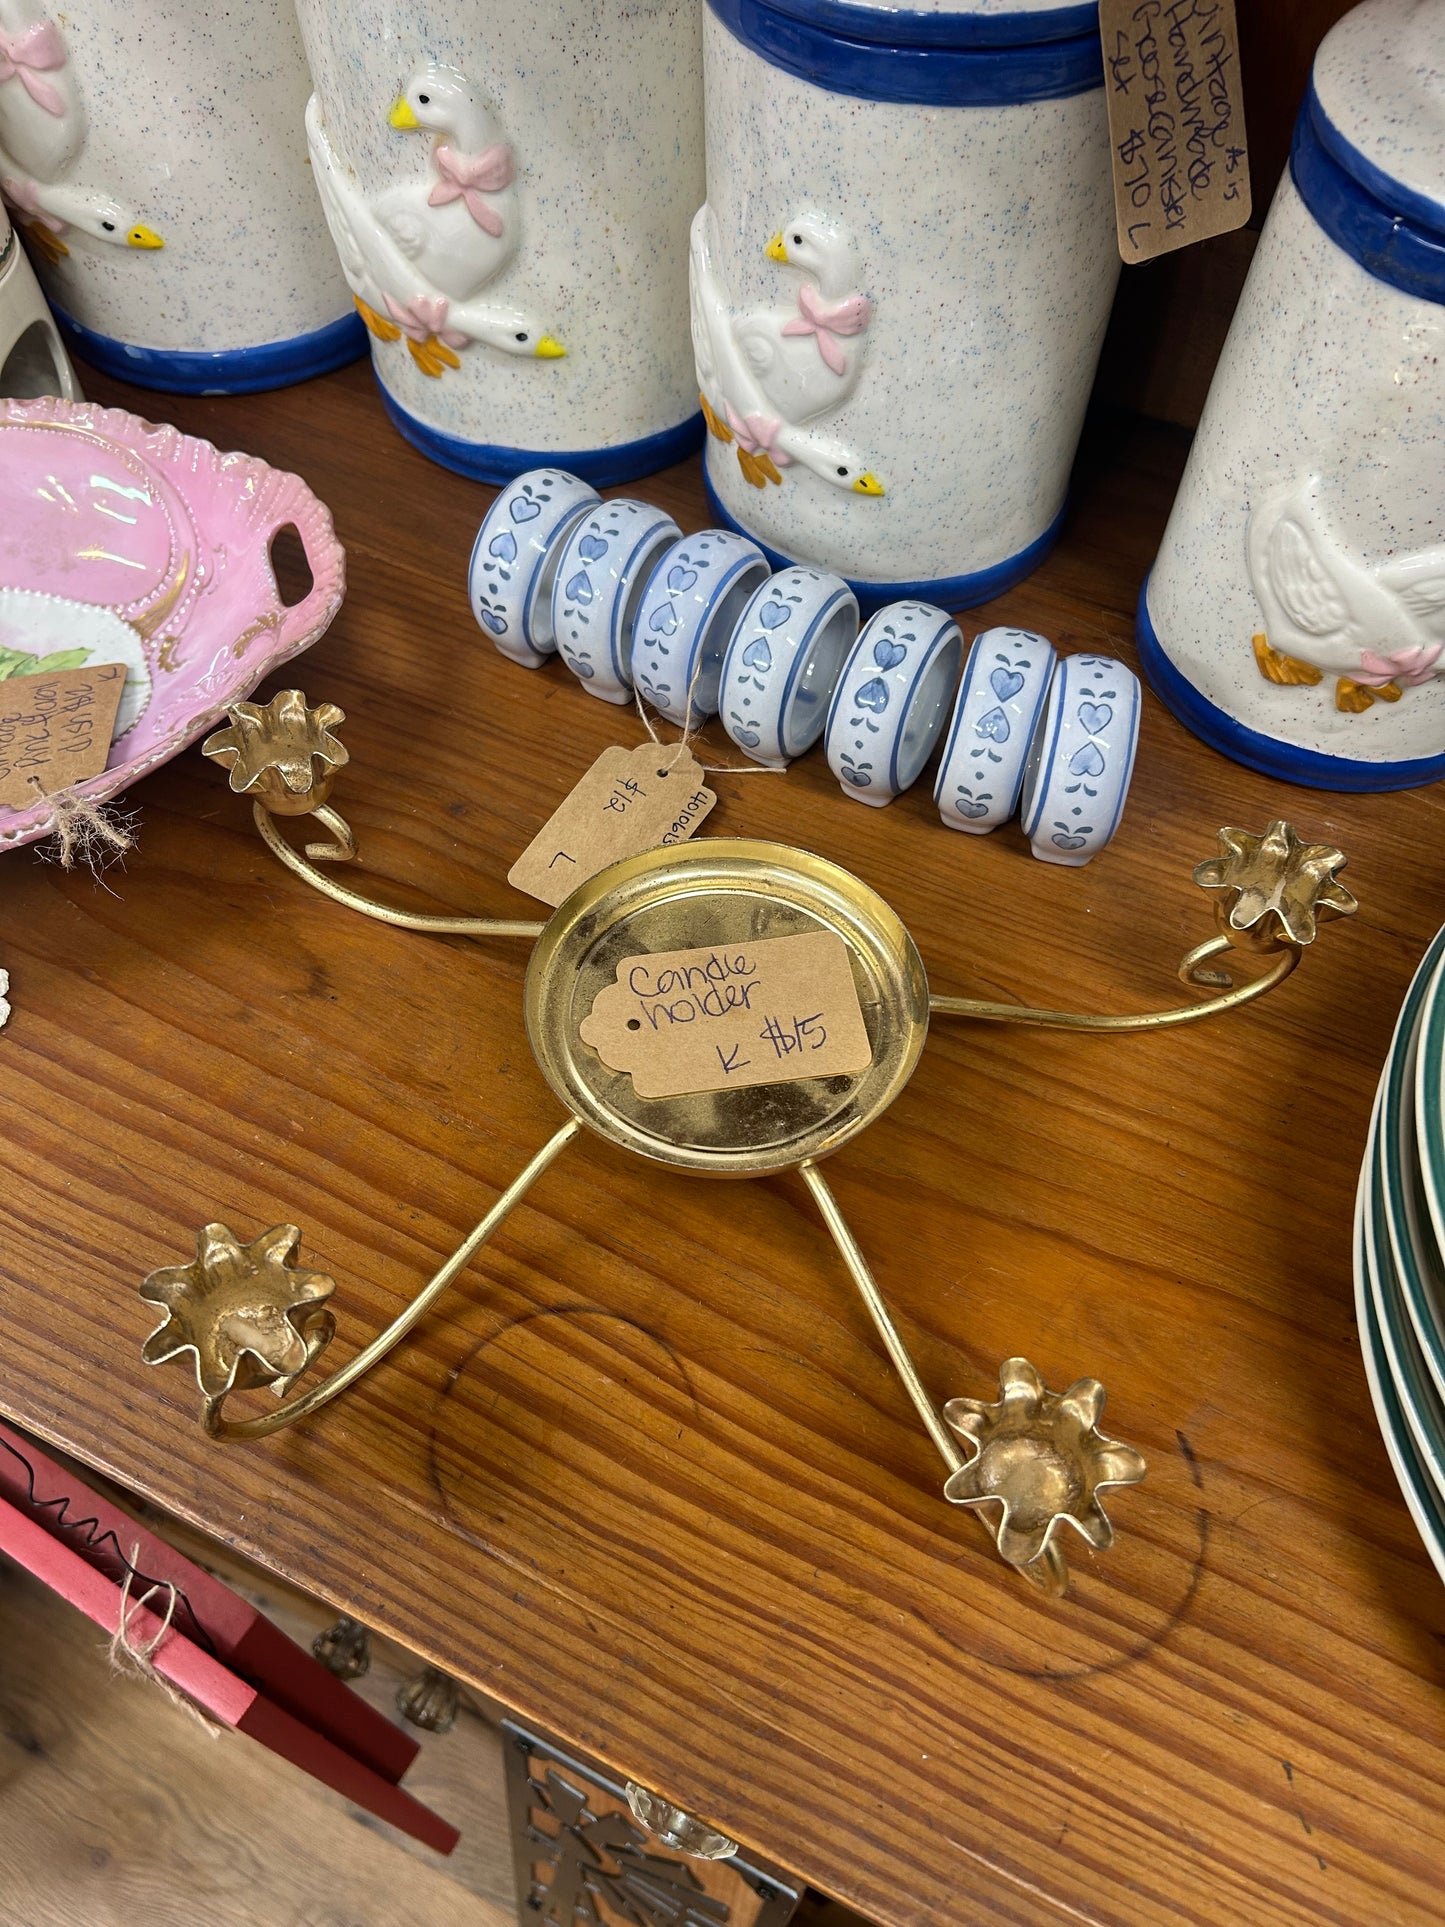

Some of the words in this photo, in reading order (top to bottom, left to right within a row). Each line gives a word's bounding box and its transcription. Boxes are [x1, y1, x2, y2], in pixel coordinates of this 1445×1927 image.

[1117, 129, 1152, 209] $70
[1127, 222, 1151, 250] L
[603, 777, 646, 813] $12
[549, 851, 577, 869] L
[629, 953, 757, 997] Candle
[640, 979, 761, 1030] holder
[716, 1043, 751, 1075] K
[759, 1013, 827, 1058] $15
